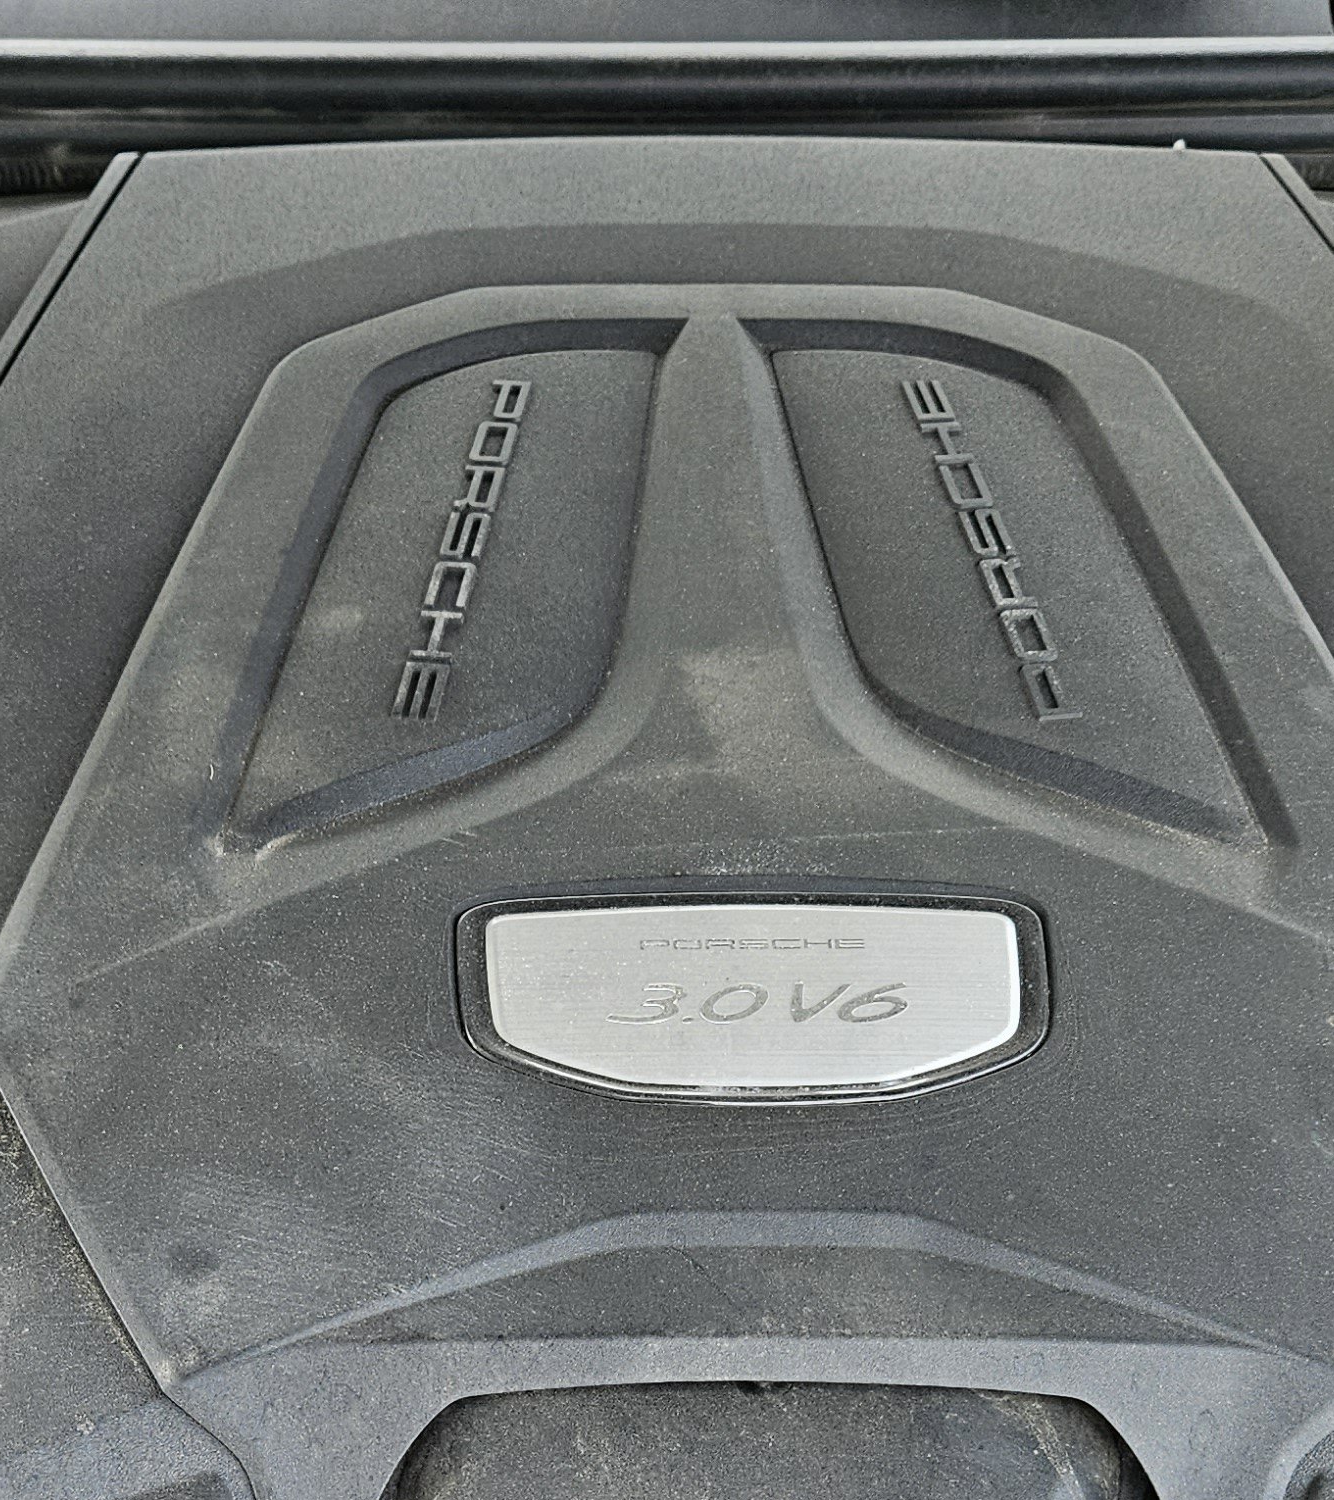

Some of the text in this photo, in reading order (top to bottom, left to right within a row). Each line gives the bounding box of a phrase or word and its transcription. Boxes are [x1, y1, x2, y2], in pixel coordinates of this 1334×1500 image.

[390, 379, 531, 721] PORSCHE
[901, 379, 1082, 722] PORSCHE
[639, 937, 866, 950] PORSCHE
